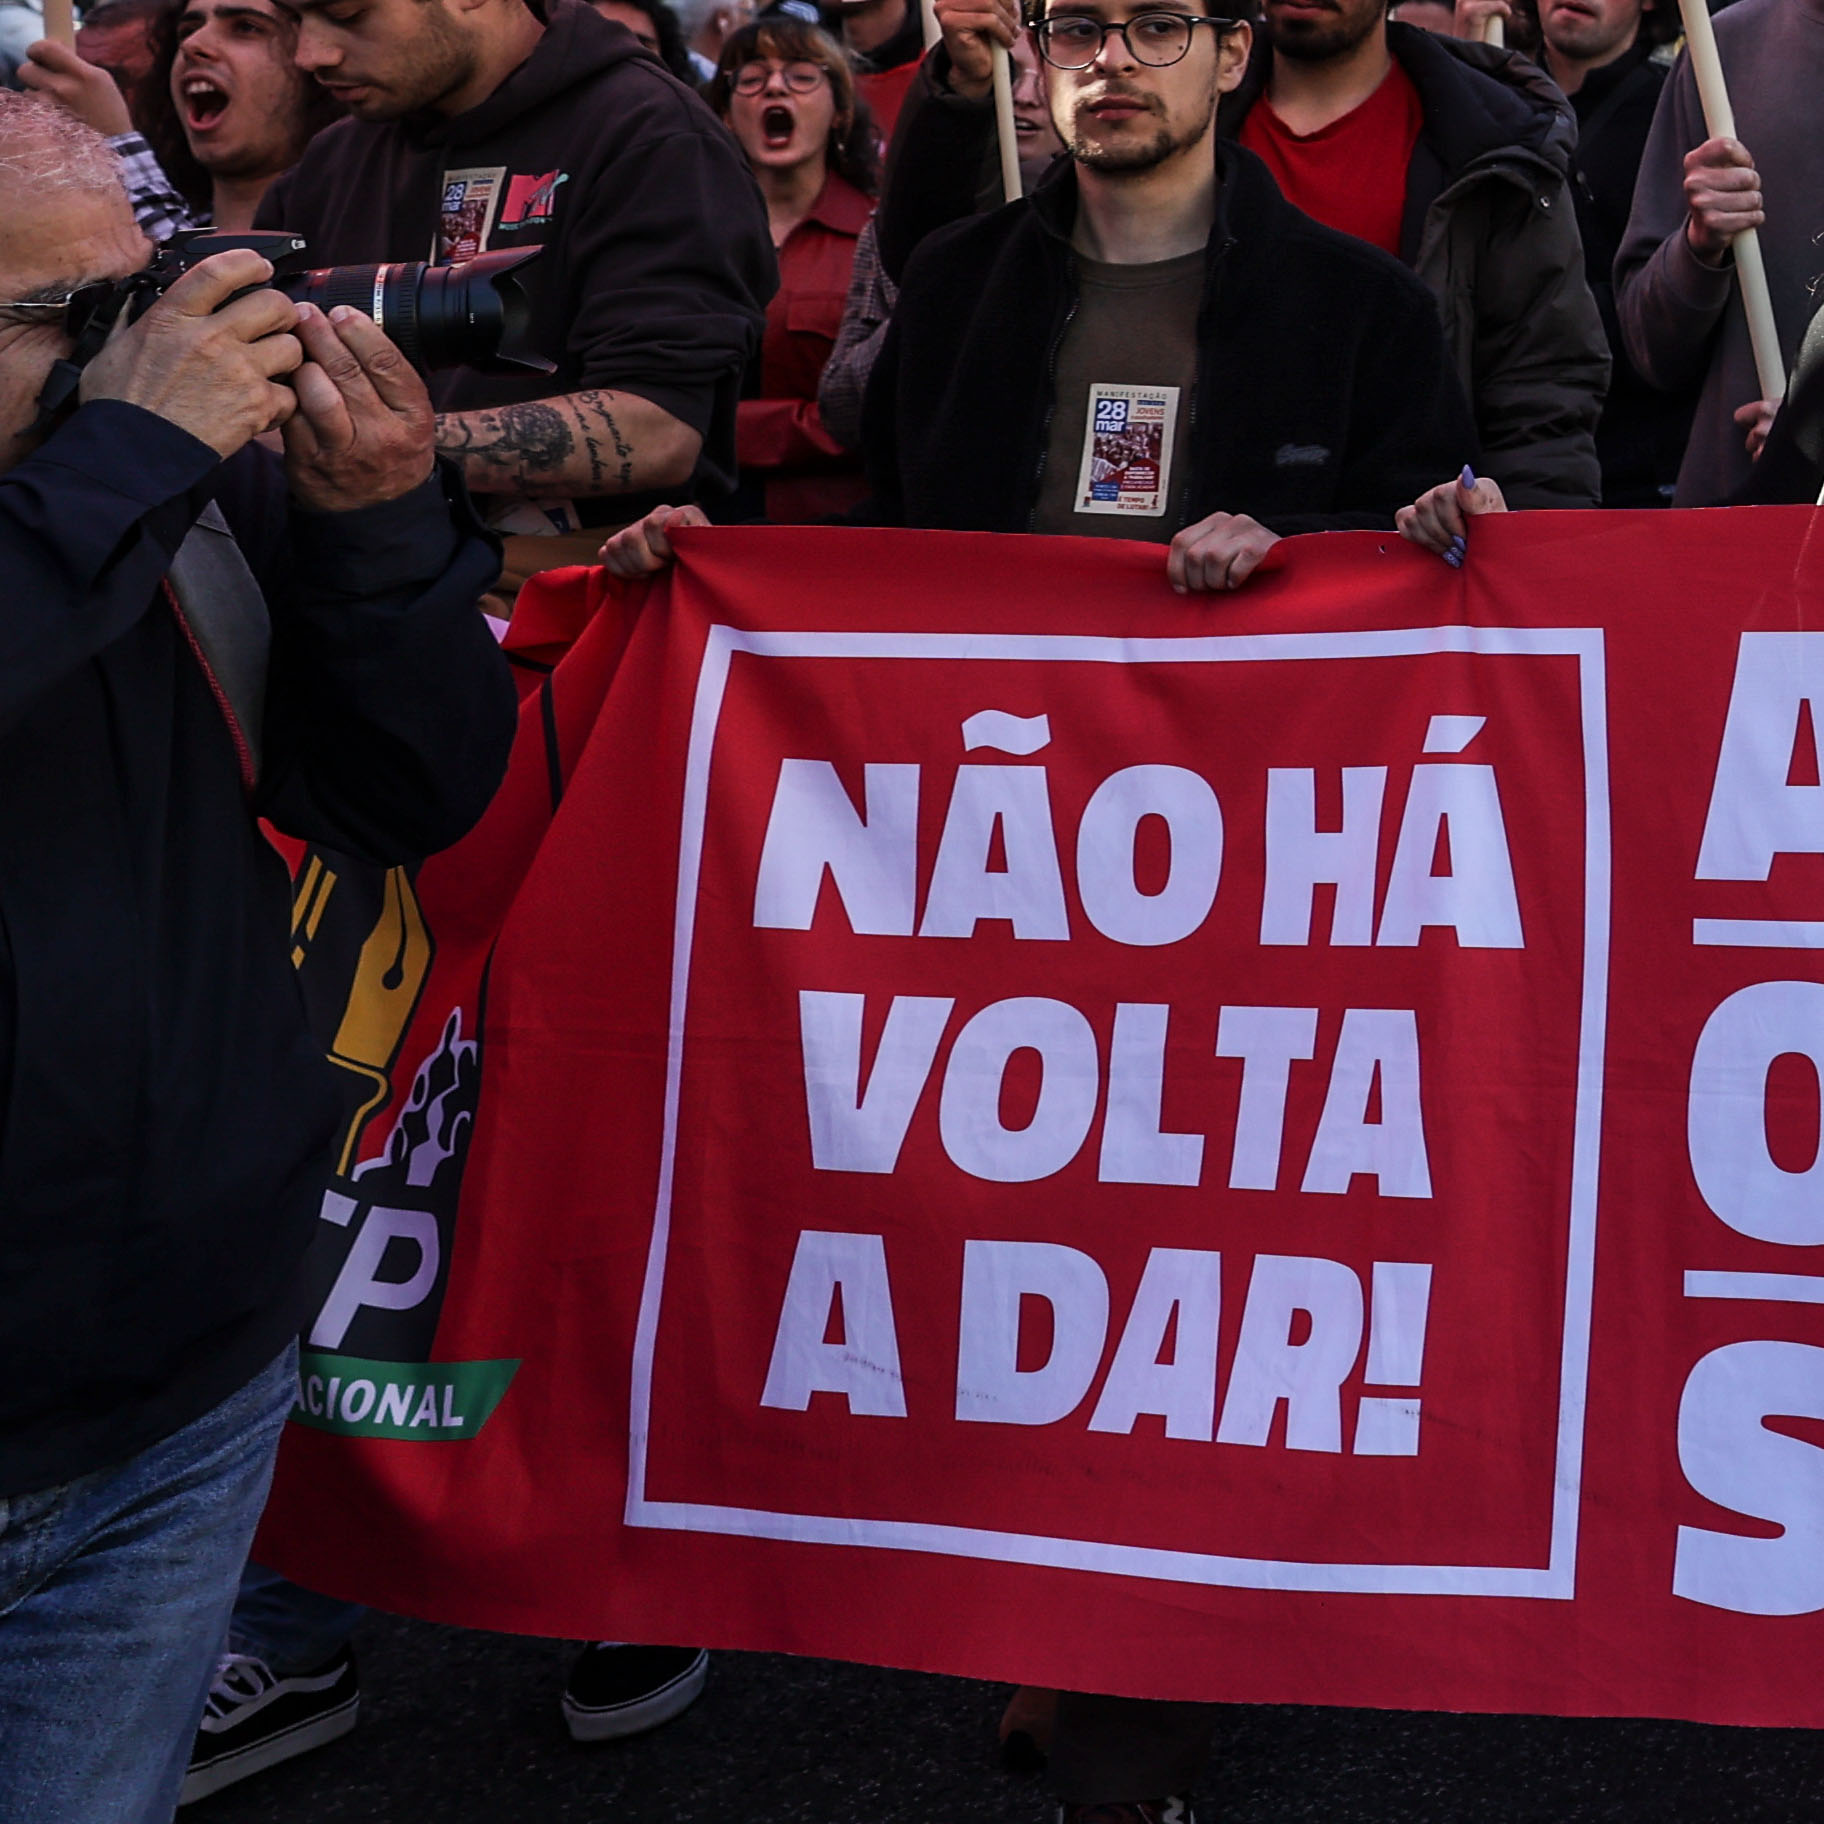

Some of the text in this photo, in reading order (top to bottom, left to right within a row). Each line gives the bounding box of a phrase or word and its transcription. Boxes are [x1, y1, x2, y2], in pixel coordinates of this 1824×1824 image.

[1095, 420, 1125, 433] mar
[1097, 400, 1127, 420] 28
[752, 709, 1525, 950] NÃO HÁ
[798, 990, 1434, 1199] VOLTA
[760, 1229, 1433, 1457] A DAR!
